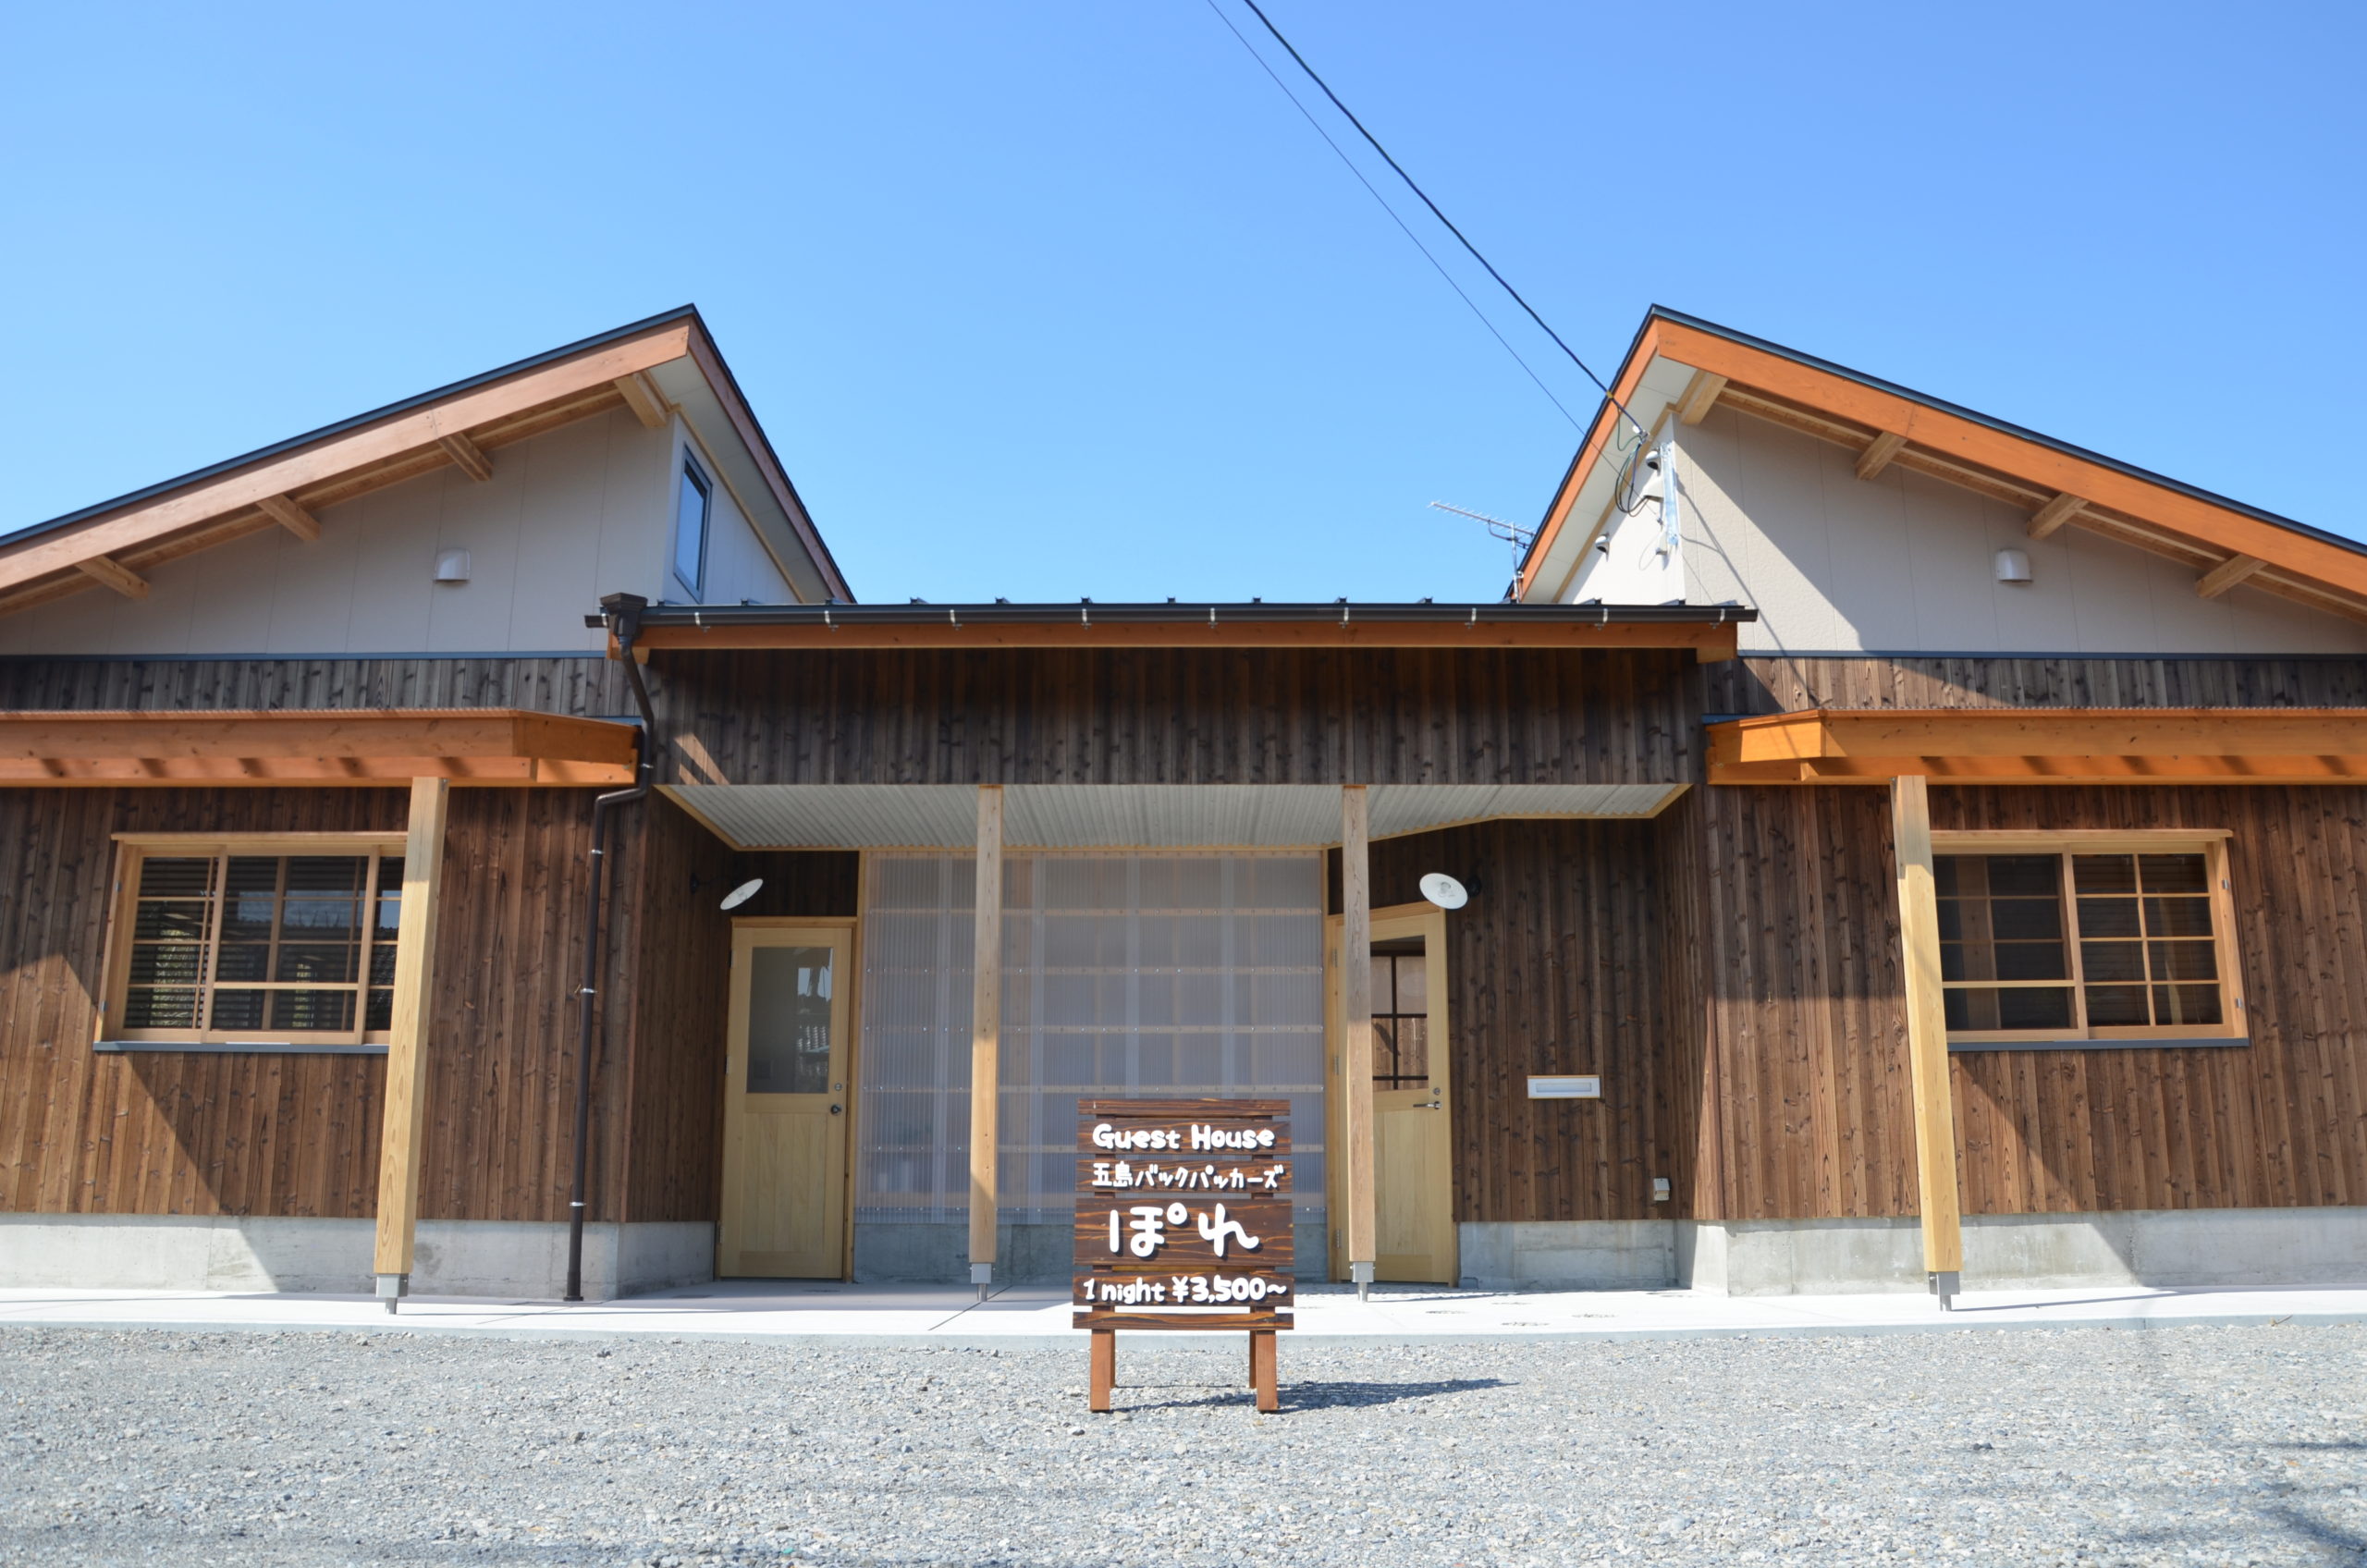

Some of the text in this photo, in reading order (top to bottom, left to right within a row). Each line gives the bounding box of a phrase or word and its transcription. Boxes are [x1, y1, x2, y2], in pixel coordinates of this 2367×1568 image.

[1092, 1123, 1275, 1150] Guest House
[1092, 1160, 1284, 1189] 五島バックパッカーズ
[1110, 1202, 1259, 1257] ぽれ
[1083, 1278, 1096, 1301] 1
[1101, 1277, 1165, 1305] night
